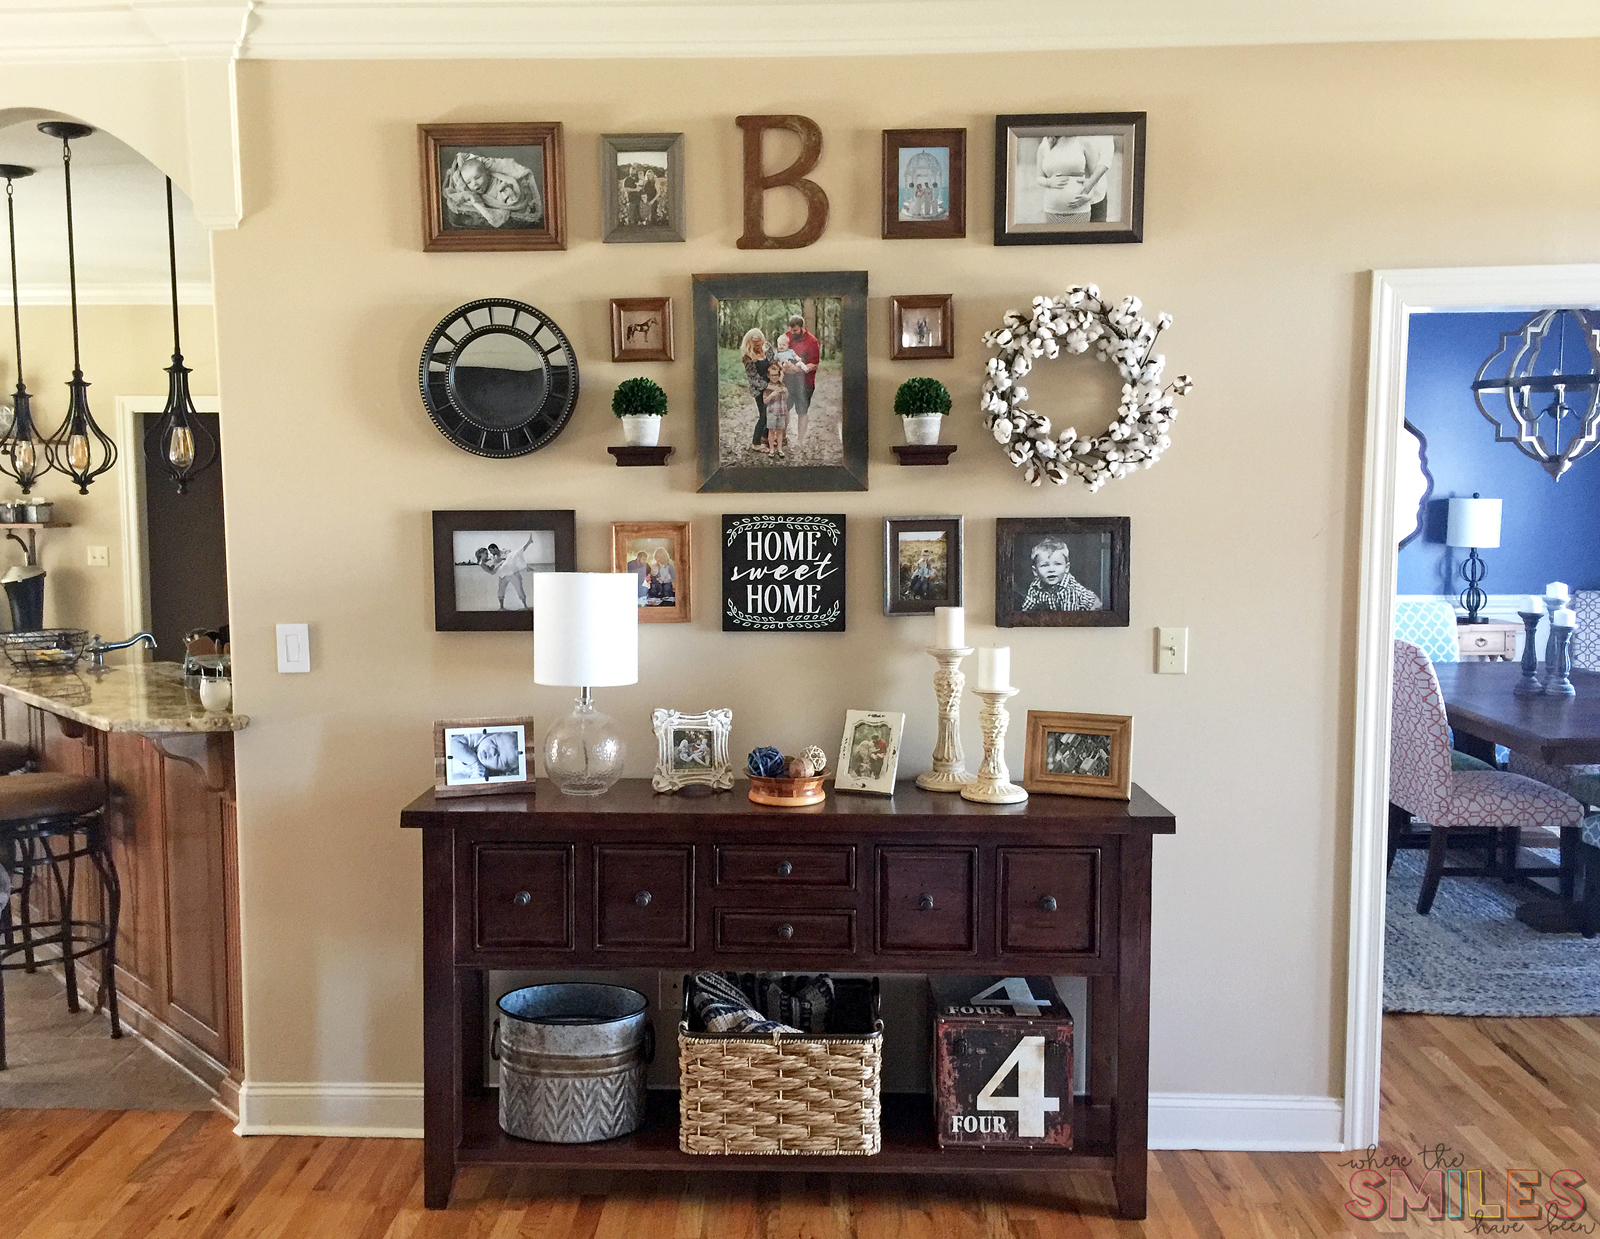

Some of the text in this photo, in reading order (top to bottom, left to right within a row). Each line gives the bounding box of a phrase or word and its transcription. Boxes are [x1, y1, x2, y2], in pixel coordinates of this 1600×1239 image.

[735, 115, 829, 249] B
[747, 531, 822, 561] HOME
[730, 552, 839, 582] sweet
[747, 584, 822, 614] HOME
[949, 1006, 1005, 1015] FOUR
[970, 977, 1052, 1016] 4
[977, 1036, 1060, 1138] 4
[951, 1115, 1007, 1133] FOUR
